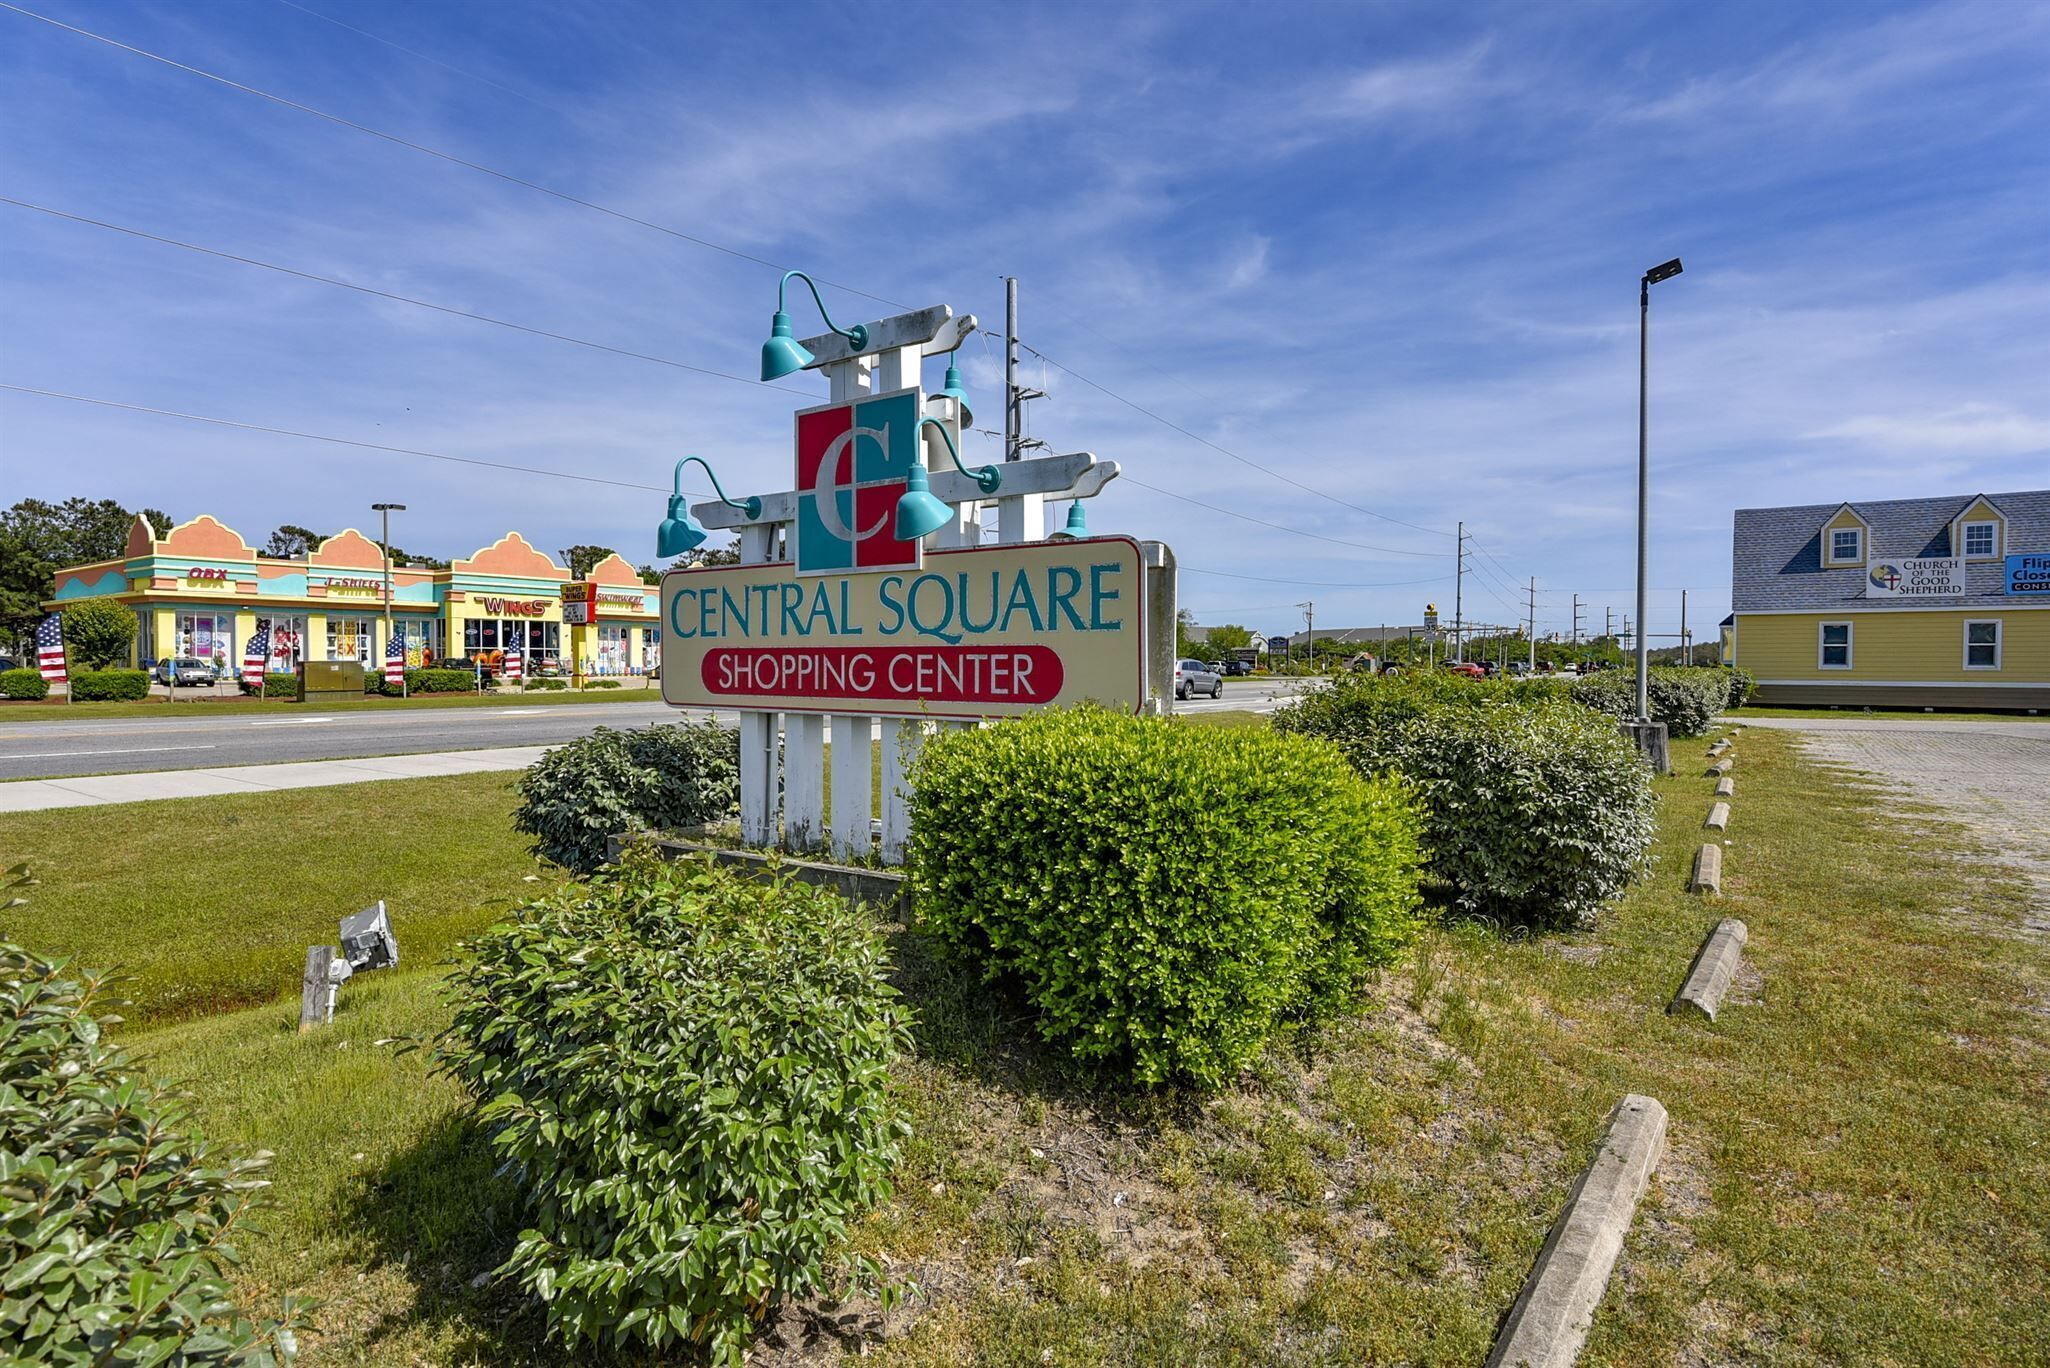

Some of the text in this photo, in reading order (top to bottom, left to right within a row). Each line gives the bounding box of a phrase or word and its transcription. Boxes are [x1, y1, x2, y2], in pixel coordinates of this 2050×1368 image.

[815, 421, 889, 541] C
[1903, 560, 1958, 570] CHURCH
[189, 567, 227, 581] OBX
[1911, 577, 1950, 585] GOOD
[566, 585, 582, 593] SUPER
[1899, 585, 1962, 594] SHEPHERD
[565, 592, 586, 600] WINGS
[474, 597, 553, 616] WINGS
[670, 562, 1122, 646] CENTRAL SQUARE
[718, 652, 1036, 696] SHOPPING CENTER
